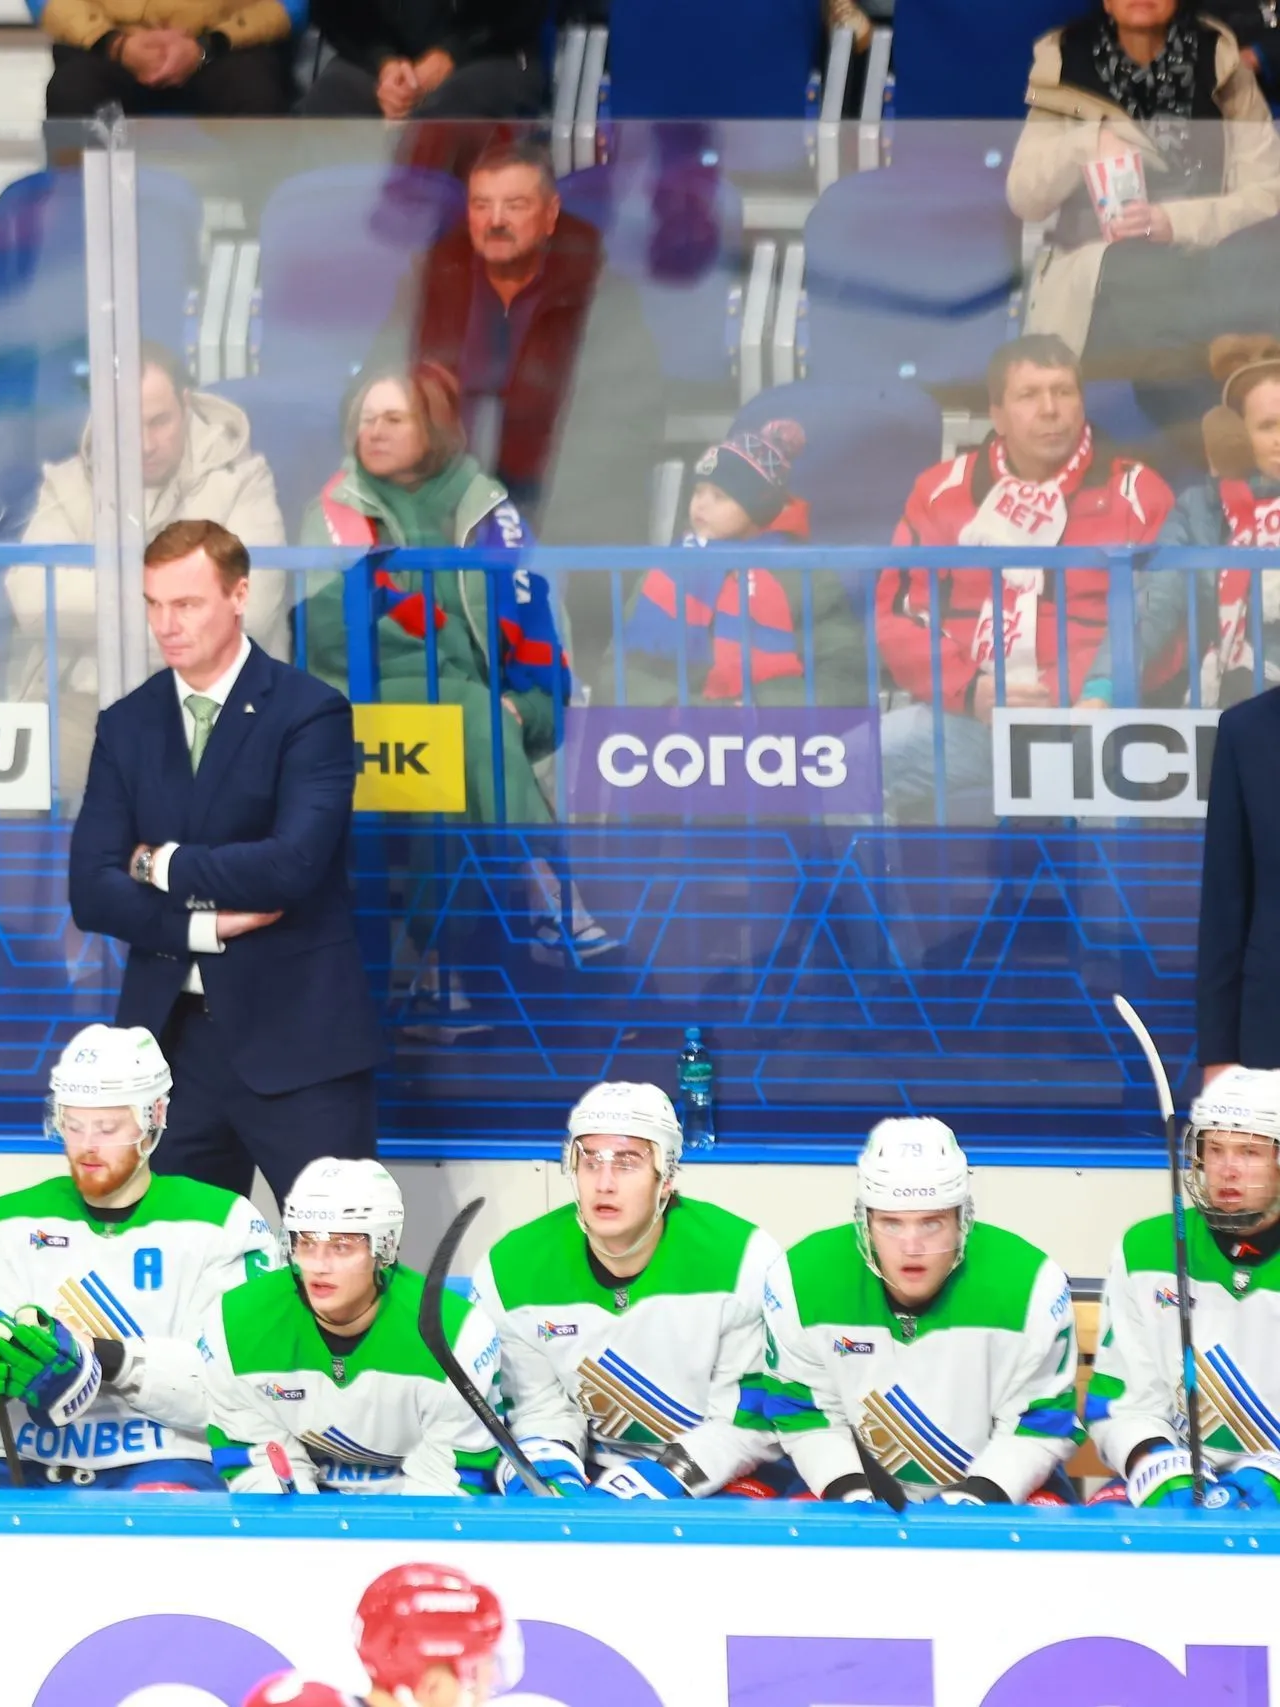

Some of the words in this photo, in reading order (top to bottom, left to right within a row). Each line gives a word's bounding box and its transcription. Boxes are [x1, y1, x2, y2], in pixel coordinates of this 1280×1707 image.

[597, 733, 847, 788] согаз
[75, 1048, 98, 1064] 65
[892, 1187, 937, 1197] согаз
[250, 1219, 272, 1234] FON
[133, 1247, 163, 1290] A
[16, 1419, 164, 1459] FONBET
